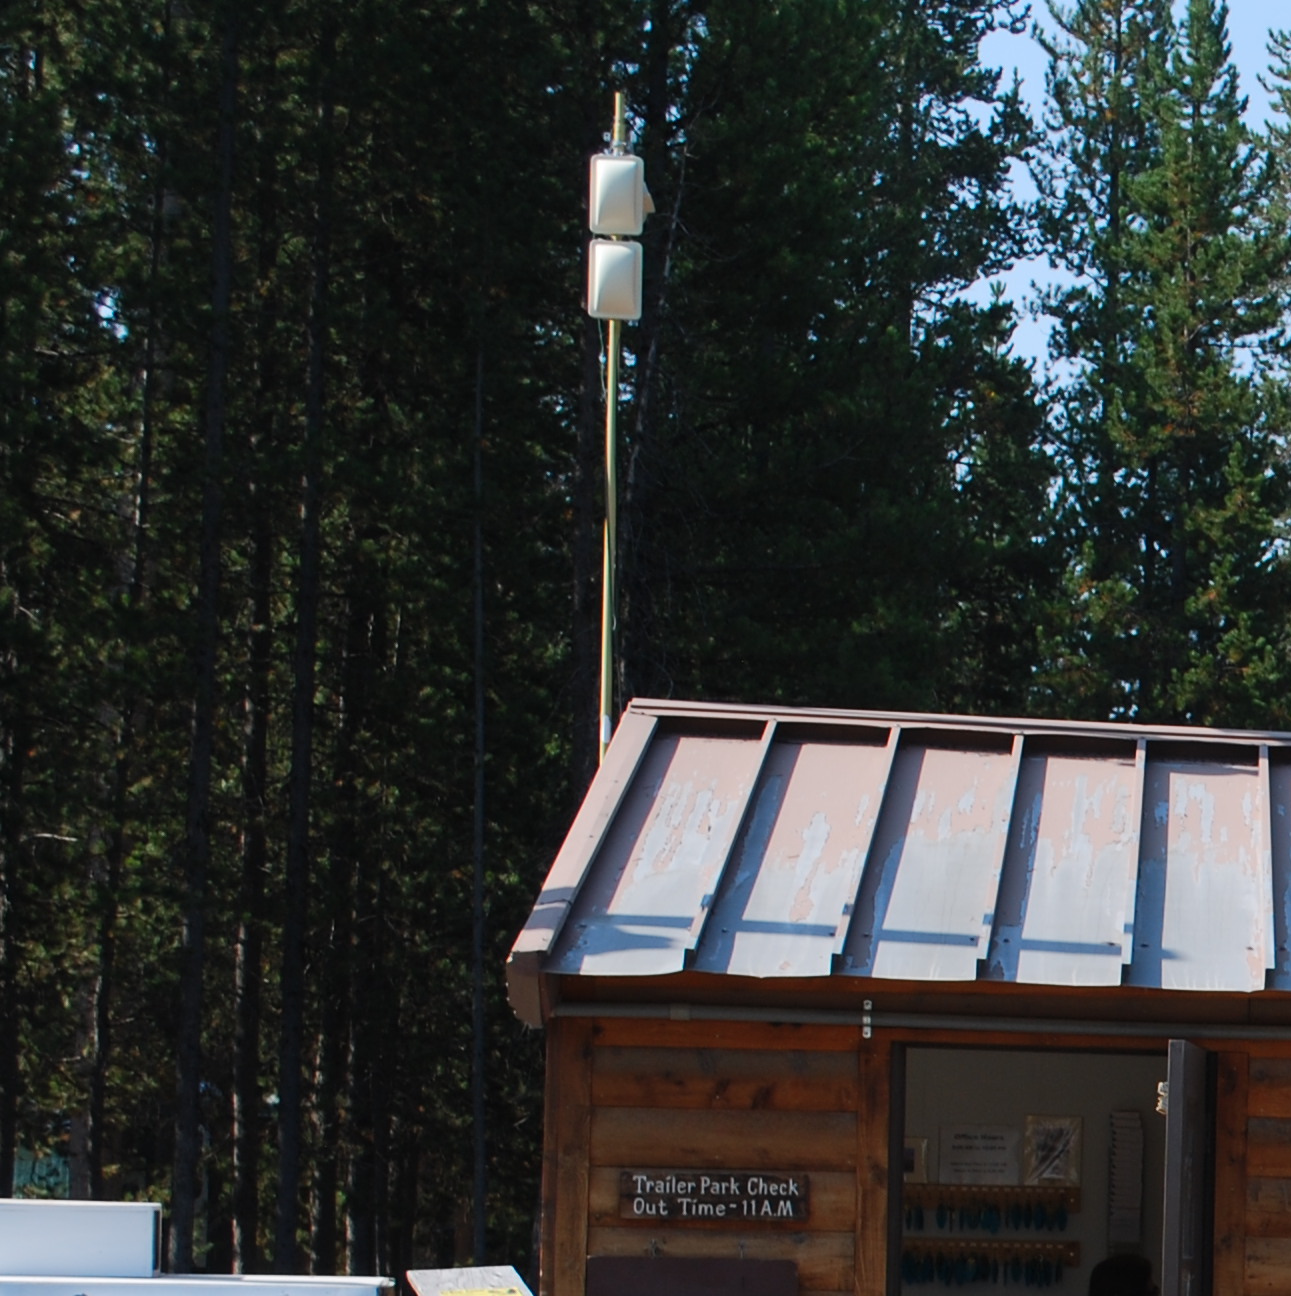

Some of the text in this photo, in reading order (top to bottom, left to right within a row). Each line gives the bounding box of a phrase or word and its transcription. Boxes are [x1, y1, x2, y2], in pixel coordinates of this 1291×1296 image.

[633, 1175, 799, 1196] Trailer Park Check
[633, 1197, 668, 1216] Out
